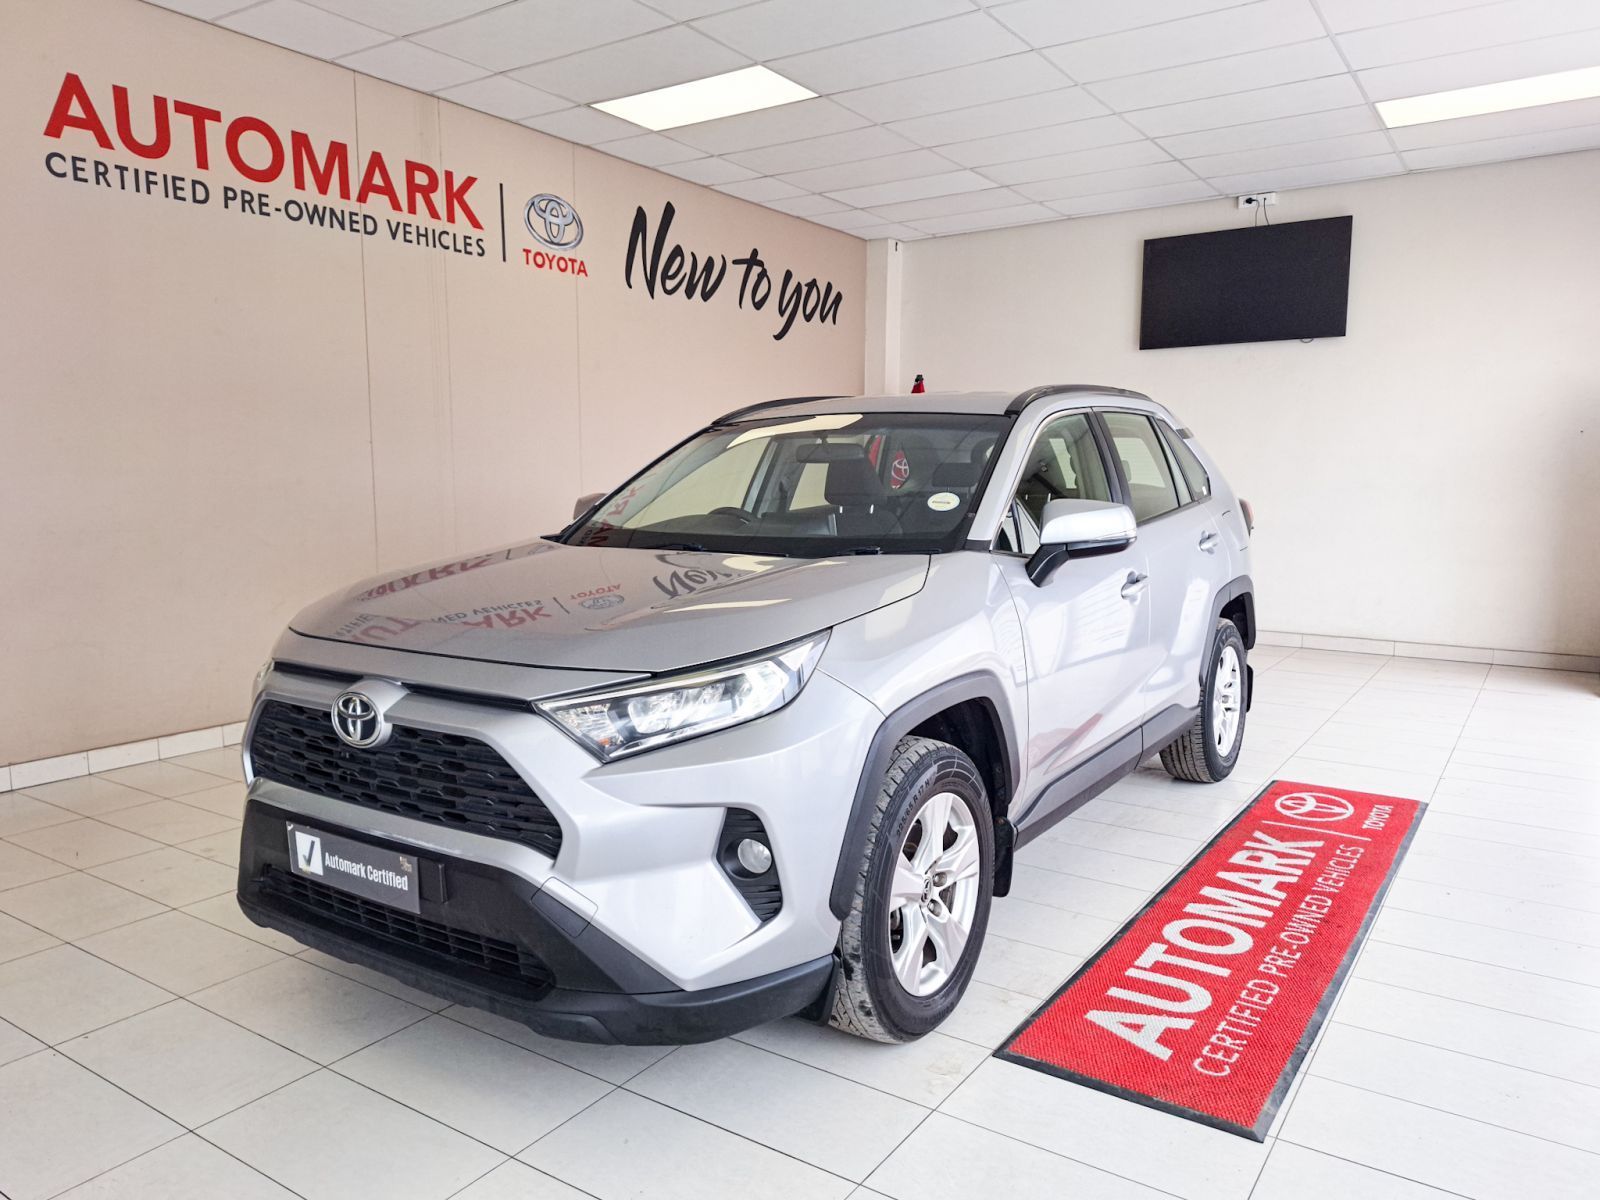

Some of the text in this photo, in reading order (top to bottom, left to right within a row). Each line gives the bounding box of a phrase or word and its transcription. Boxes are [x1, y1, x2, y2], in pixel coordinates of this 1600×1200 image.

[44, 72, 484, 231] AUTOMARK
[45, 152, 486, 257] CERTIFIED PRE-OWNED VEHICLES
[522, 248, 589, 277] TOYOTA
[624, 200, 843, 341] New to you
[324, 852, 408, 891] Automark Certified
[1361, 804, 1394, 831] TOYOTA
[1085, 831, 1325, 1062] AUTOMARK
[1193, 845, 1365, 1077] CERTIFIED PRE-OWNED VEHICLES
